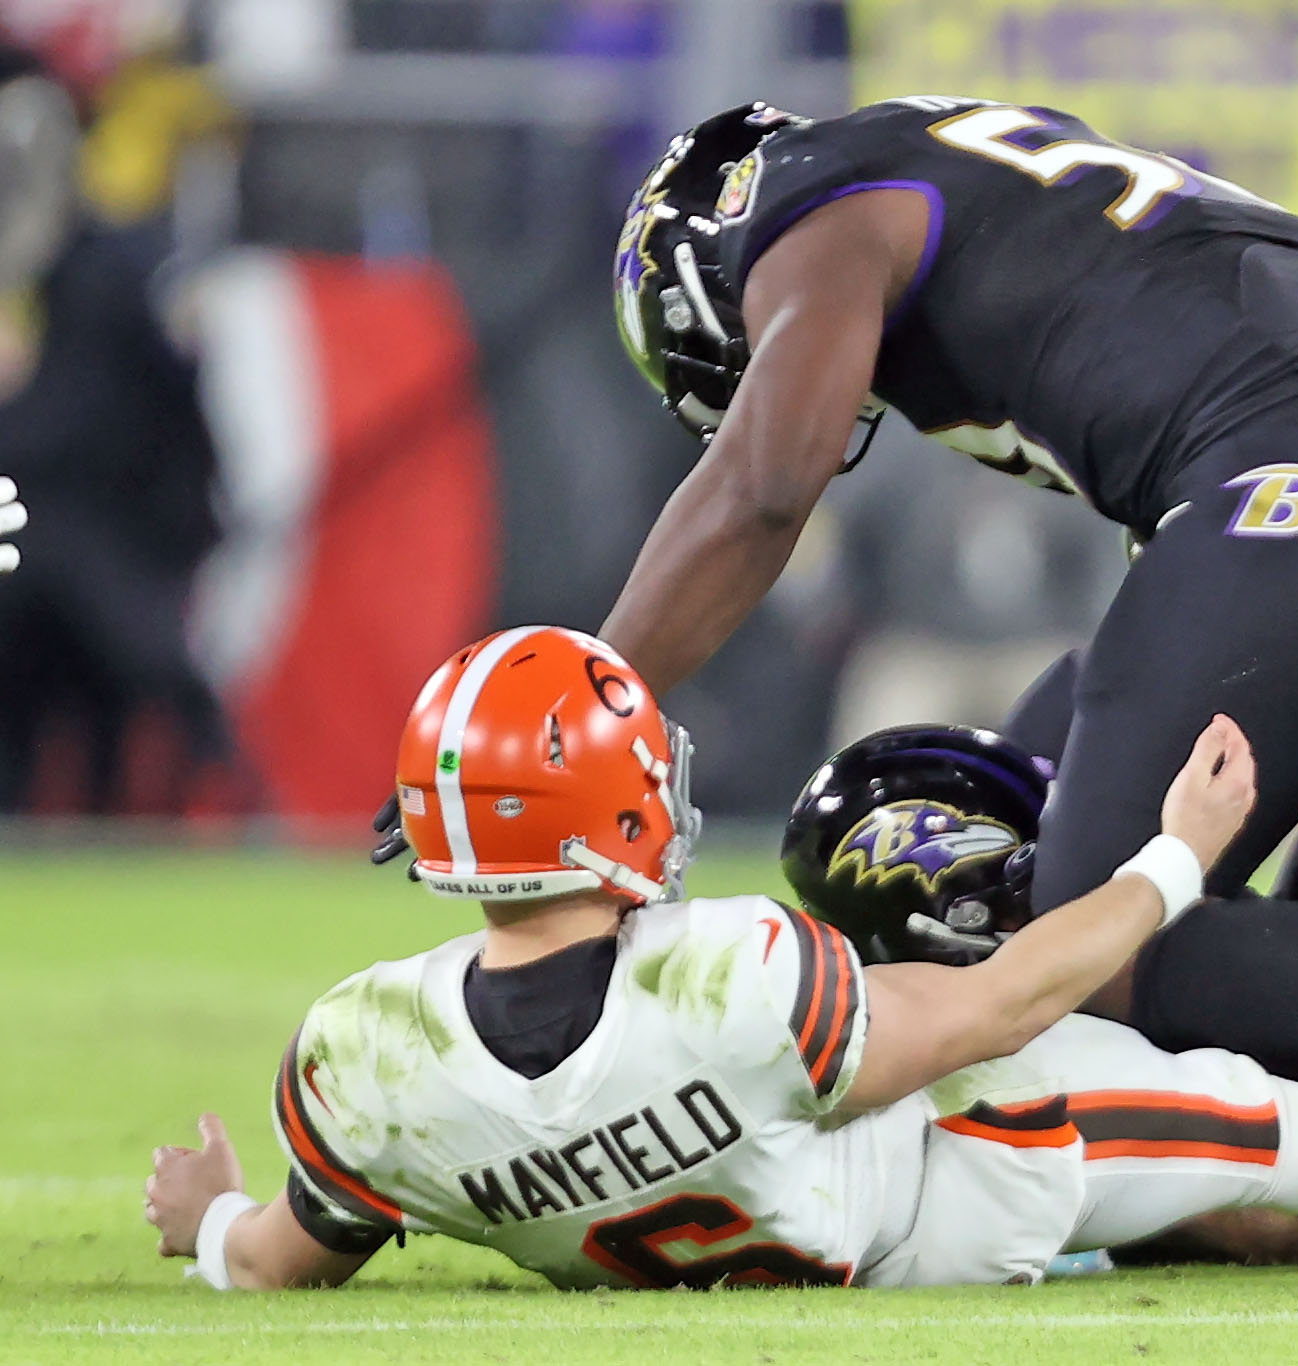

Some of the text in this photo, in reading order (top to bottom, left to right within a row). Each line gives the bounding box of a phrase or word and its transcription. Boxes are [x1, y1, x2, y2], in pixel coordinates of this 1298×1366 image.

[585, 656, 635, 718] 6
[467, 882, 493, 894] ALL
[498, 882, 516, 894] OF
[521, 880, 543, 893] US
[458, 1079, 742, 1225] MAYFIELD
